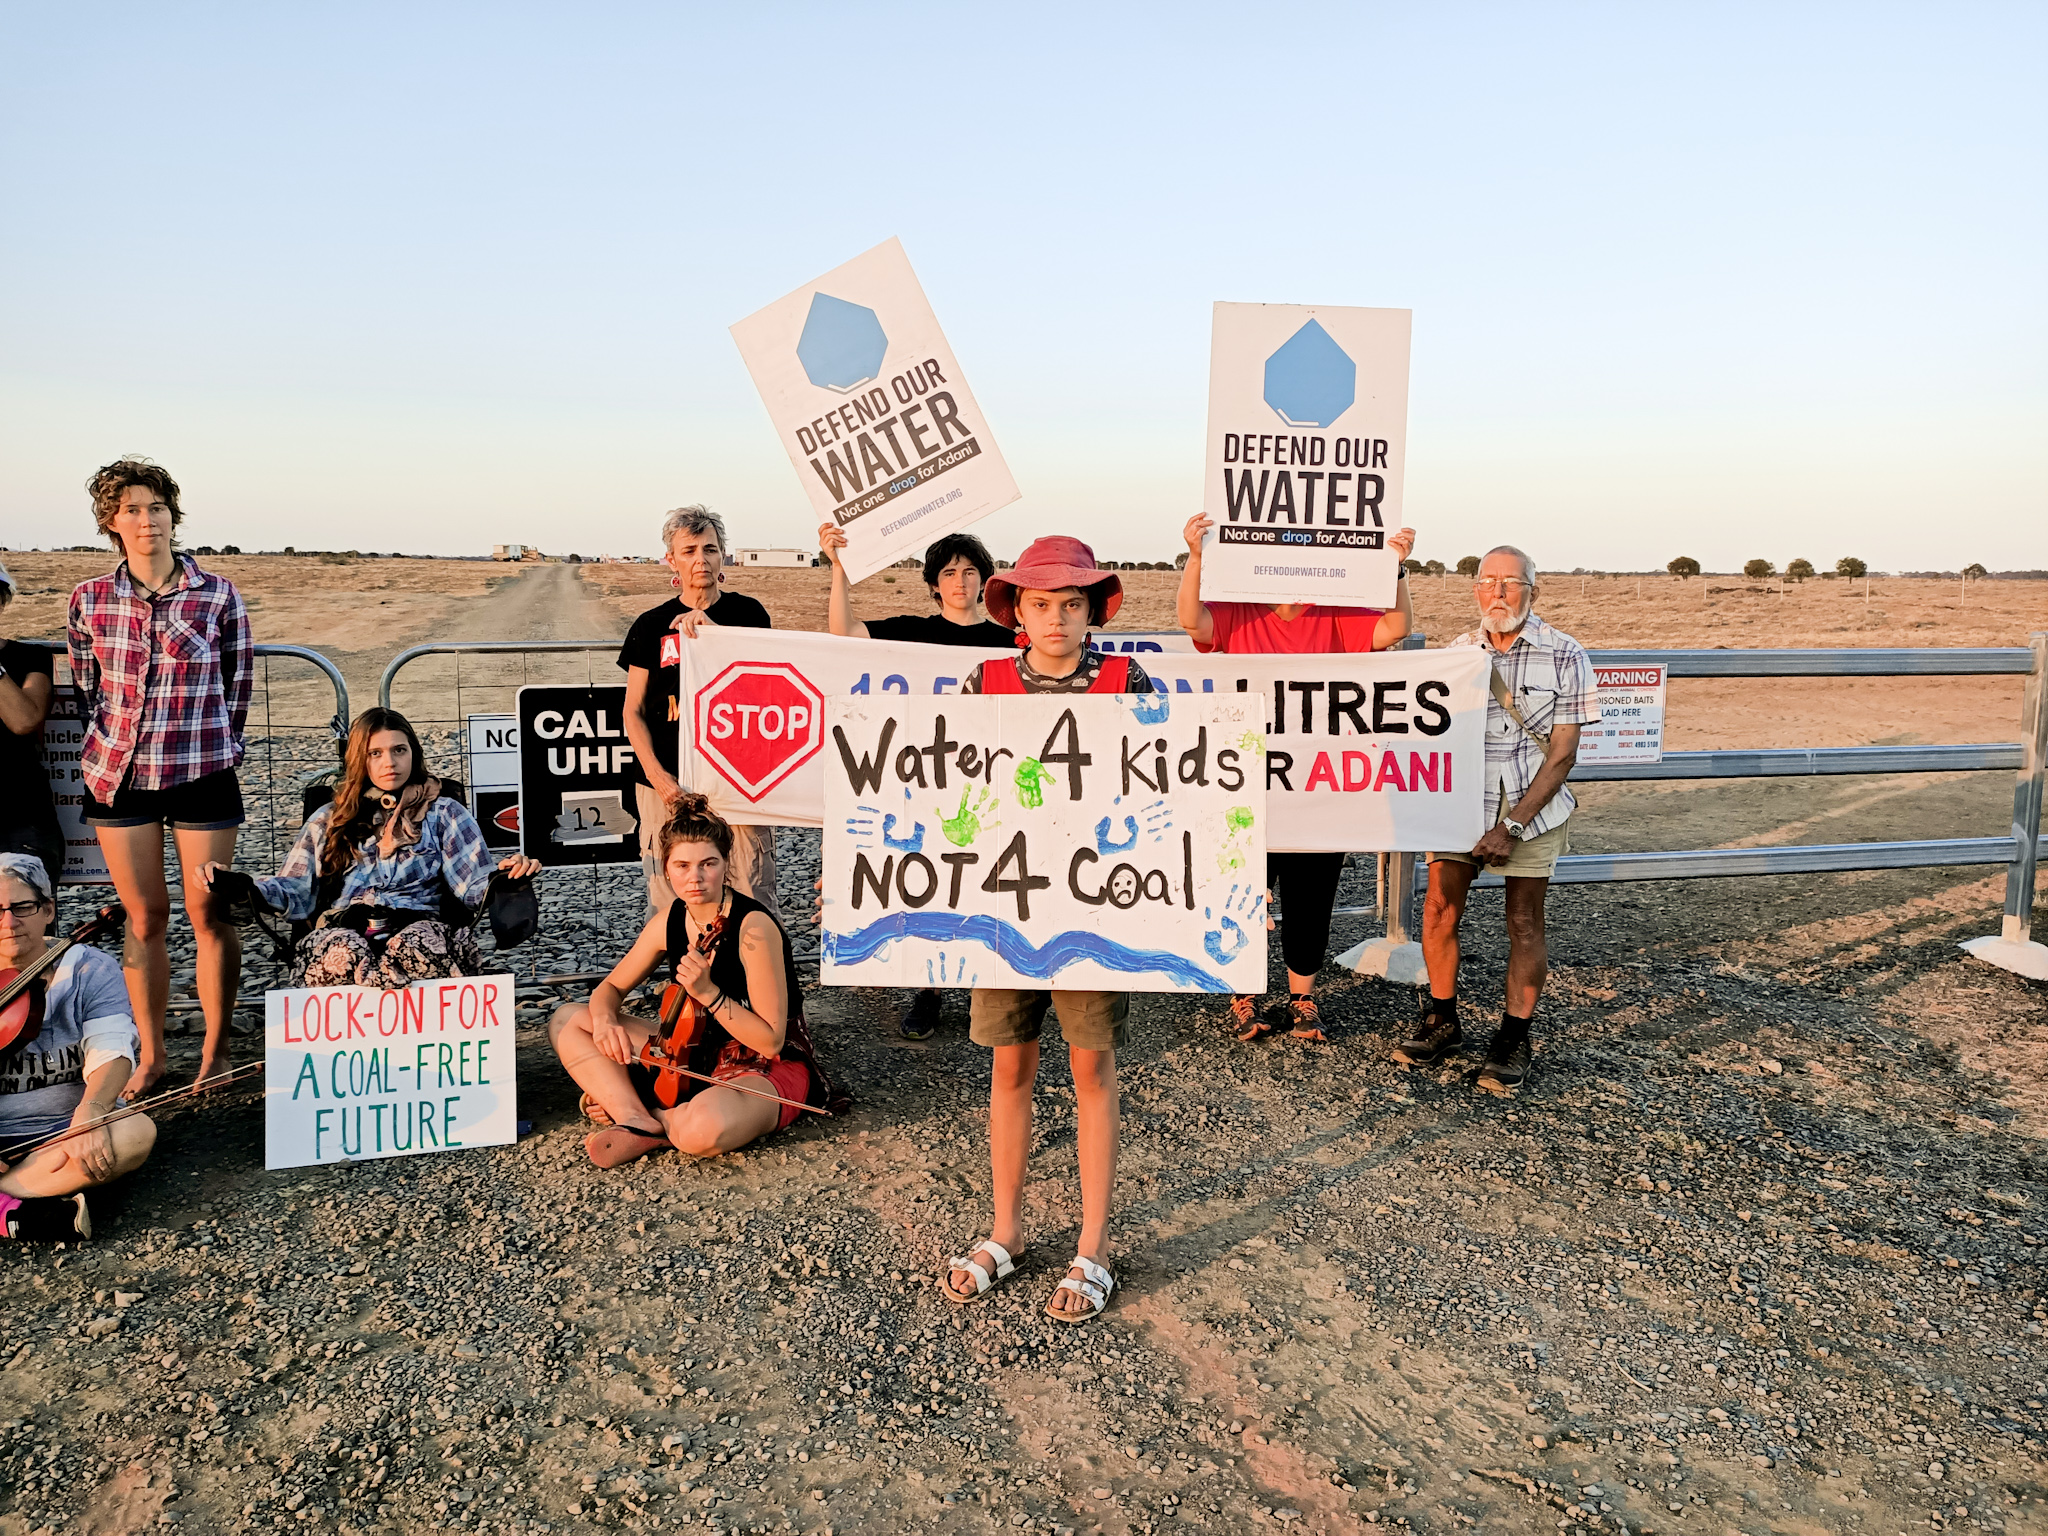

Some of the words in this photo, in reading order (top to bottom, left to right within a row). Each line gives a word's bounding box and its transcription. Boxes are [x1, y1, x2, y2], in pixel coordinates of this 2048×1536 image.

[796, 388, 891, 456] DEFEND
[891, 358, 947, 404] OUR
[810, 391, 971, 503] WATER
[1224, 433, 1326, 466] DEFEND
[1335, 437, 1389, 469] OUR
[838, 503, 862, 522] Not
[863, 491, 885, 509] one
[889, 474, 917, 495] drop
[917, 464, 936, 480] for
[938, 443, 972, 470] Adani
[1224, 468, 1385, 527] WATER
[880, 488, 963, 537] DEFENDOURWATER.ORG
[1224, 528, 1248, 541] Not
[1251, 532, 1276, 542] one
[1281, 530, 1312, 546] drop
[1316, 532, 1335, 544] for
[1337, 533, 1376, 546] Adani
[1254, 565, 1346, 578] DEFENDOURWATER.ORG
[710, 702, 810, 741] STOP
[1601, 708, 1620, 717] LAID
[1622, 708, 1641, 717] HERE
[1634, 696, 1654, 704] BAITS
[534, 710, 629, 740] CAL
[548, 745, 635, 776] UHF
[832, 714, 1014, 797] Water
[1039, 708, 1092, 801] 4
[1304, 750, 1452, 792] ADANI
[571, 806, 606, 832] 12
[851, 851, 979, 910] NOT
[981, 831, 1051, 921] 4
[1068, 831, 1197, 911] Coal
[284, 986, 425, 1044] LOCK-ON
[439, 983, 500, 1032] FOR
[292, 1052, 321, 1100] A
[332, 1039, 491, 1099] COAL-FREE
[315, 1096, 462, 1160] FUTURE
